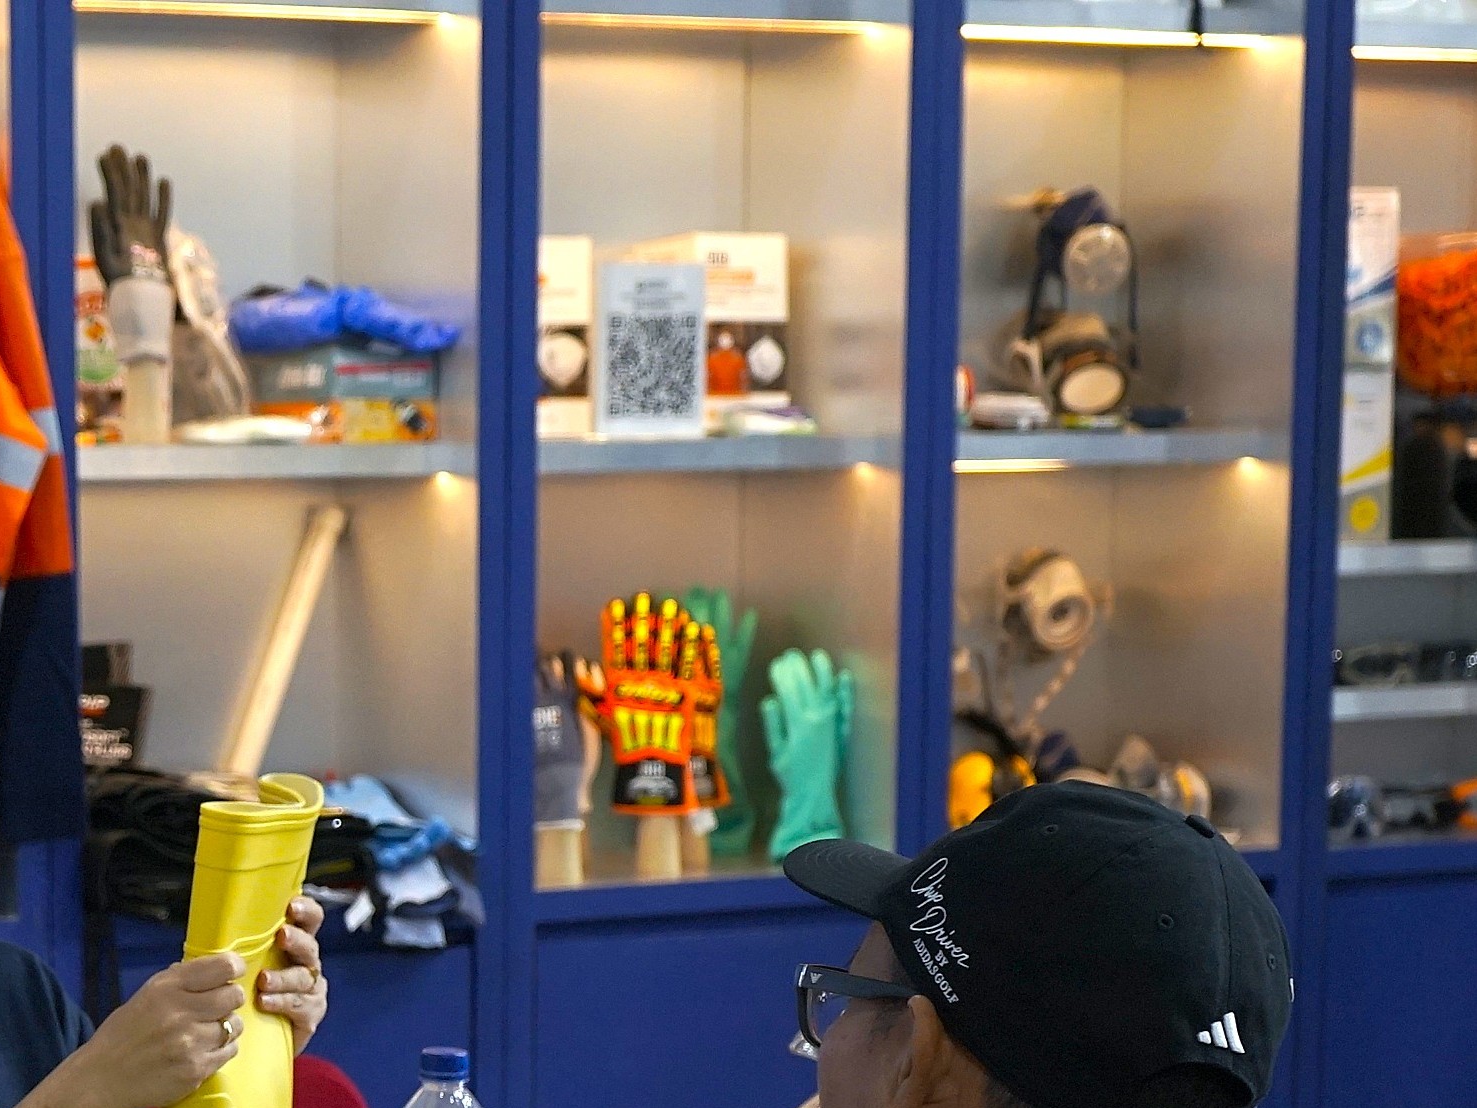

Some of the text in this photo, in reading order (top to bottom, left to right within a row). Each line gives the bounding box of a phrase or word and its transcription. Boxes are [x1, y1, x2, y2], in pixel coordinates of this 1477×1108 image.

[909, 857, 970, 969] Chip Driver
[934, 949, 950, 967] BY
